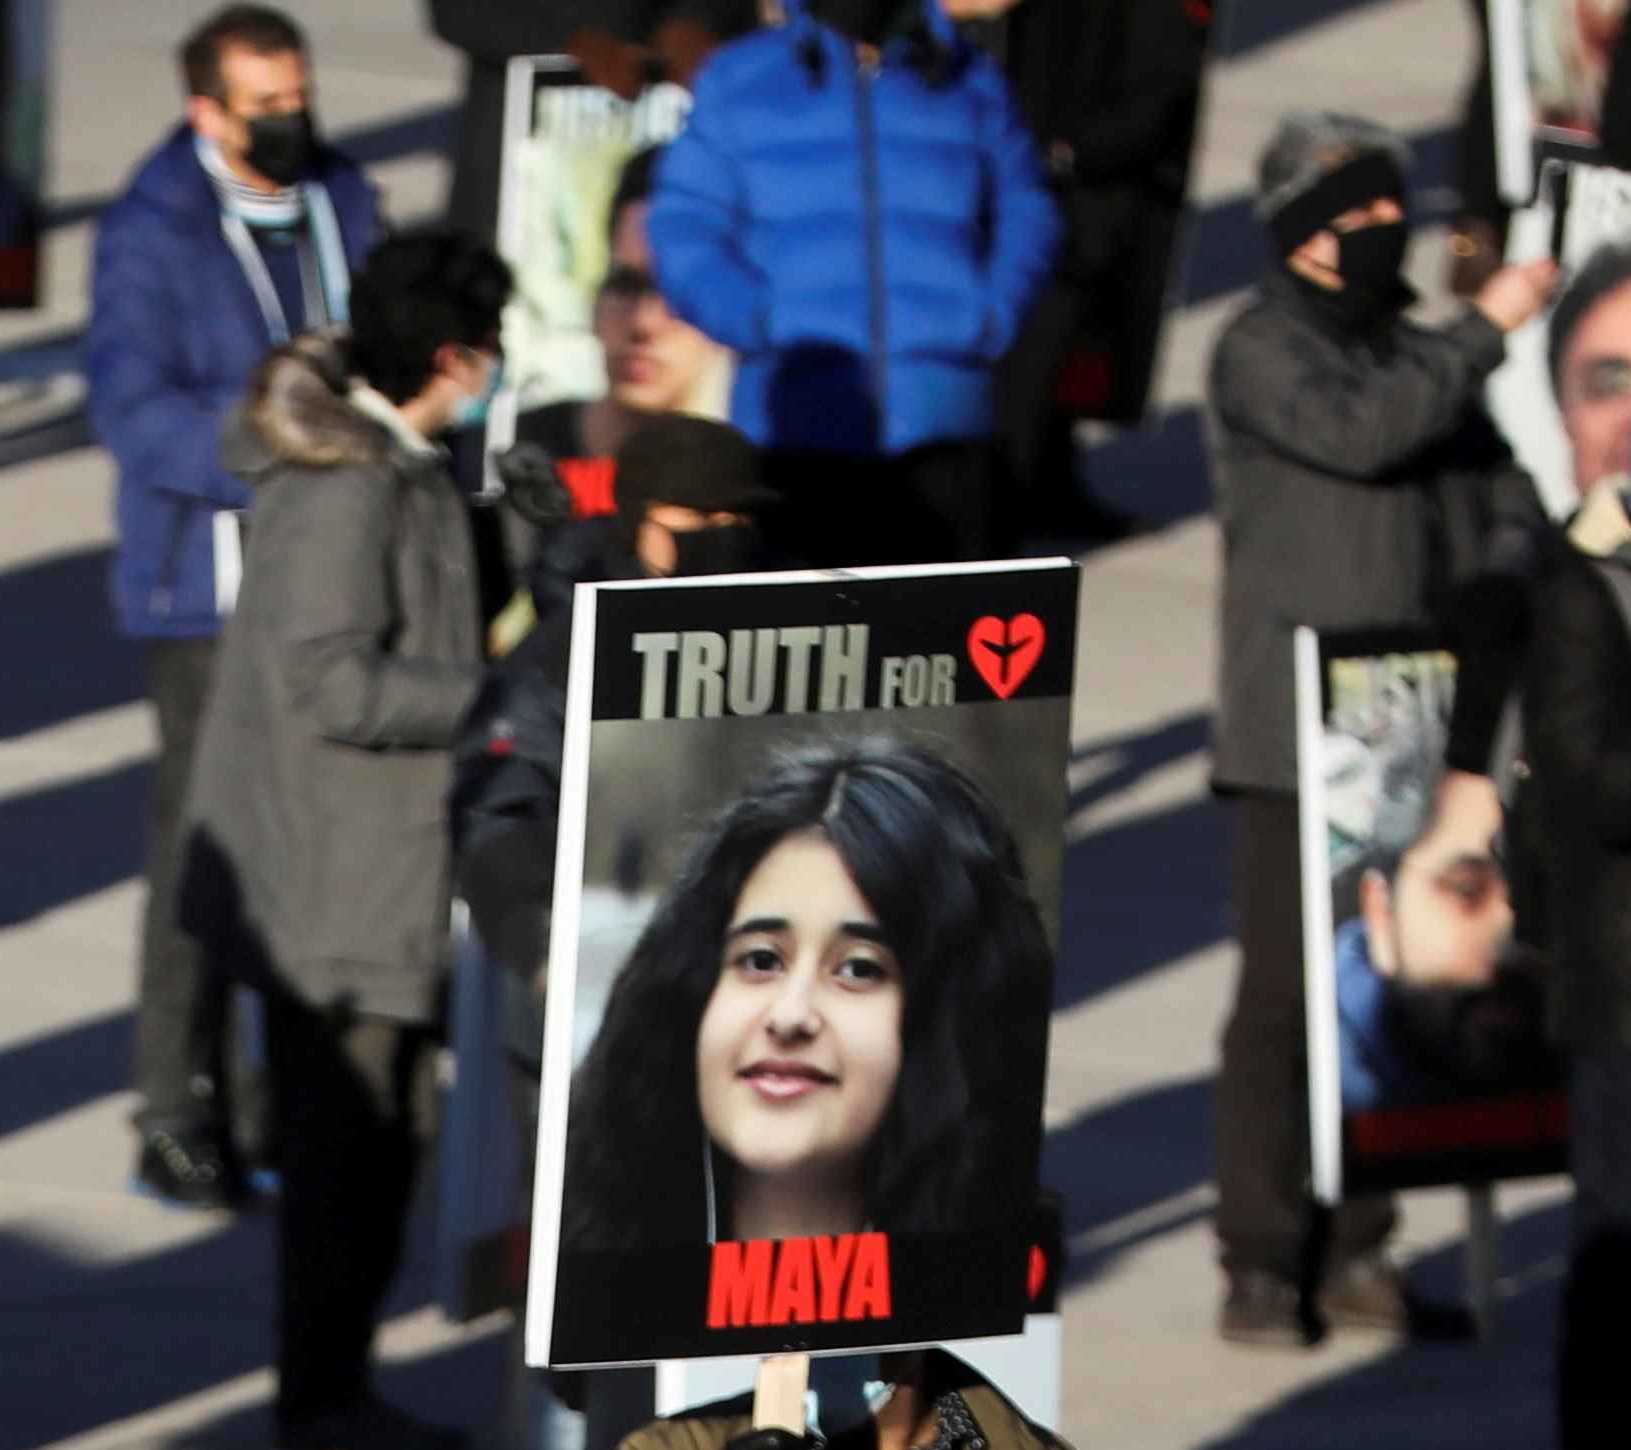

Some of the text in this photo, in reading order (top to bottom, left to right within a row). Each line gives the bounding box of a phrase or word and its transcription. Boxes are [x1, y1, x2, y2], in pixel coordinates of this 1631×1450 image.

[632, 623, 956, 720] TRUTH FOR
[707, 1232, 892, 1328] MAYA
